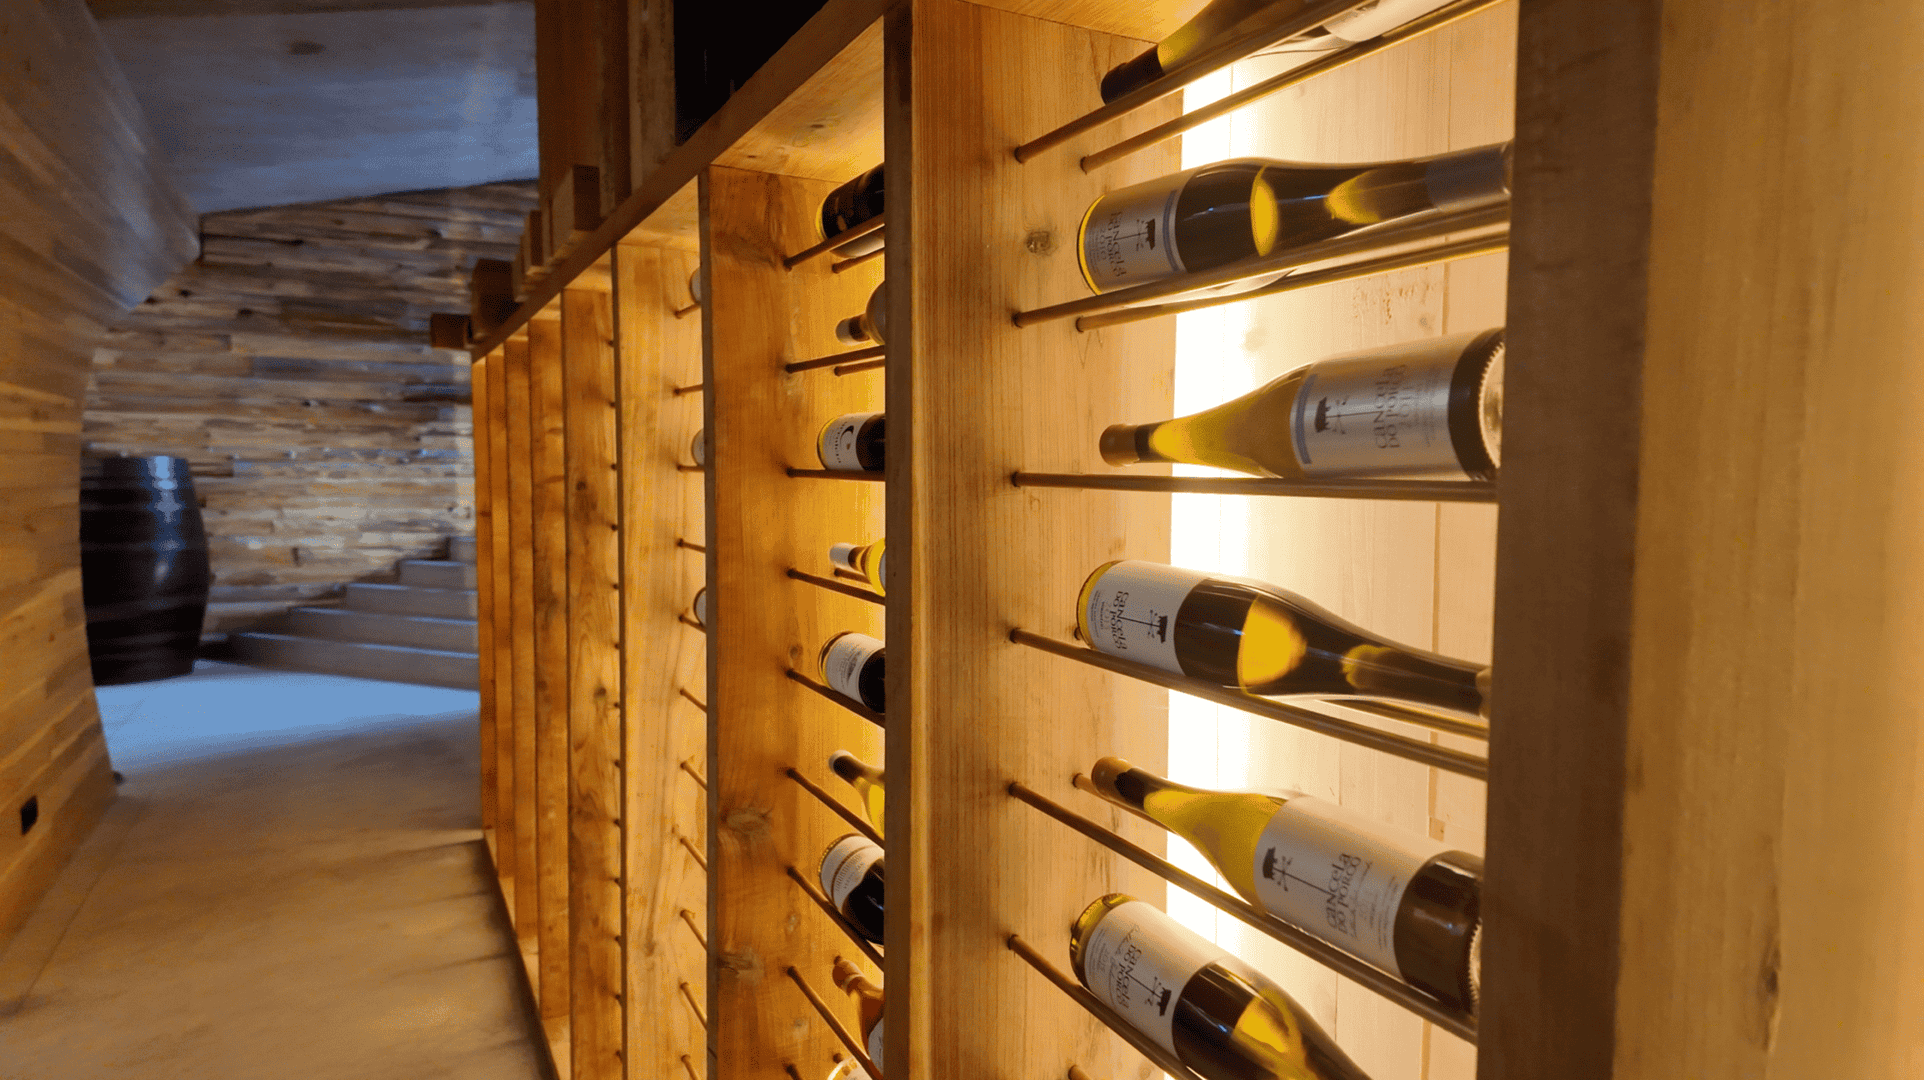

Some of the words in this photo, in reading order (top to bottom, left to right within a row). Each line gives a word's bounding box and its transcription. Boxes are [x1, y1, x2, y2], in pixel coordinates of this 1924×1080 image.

[1113, 591, 1123, 607] DO
[1109, 610, 1121, 649] PORCO
[1337, 856, 1361, 908] PORCO
[1338, 911, 1348, 934] DO
[1124, 944, 1137, 962] DO
